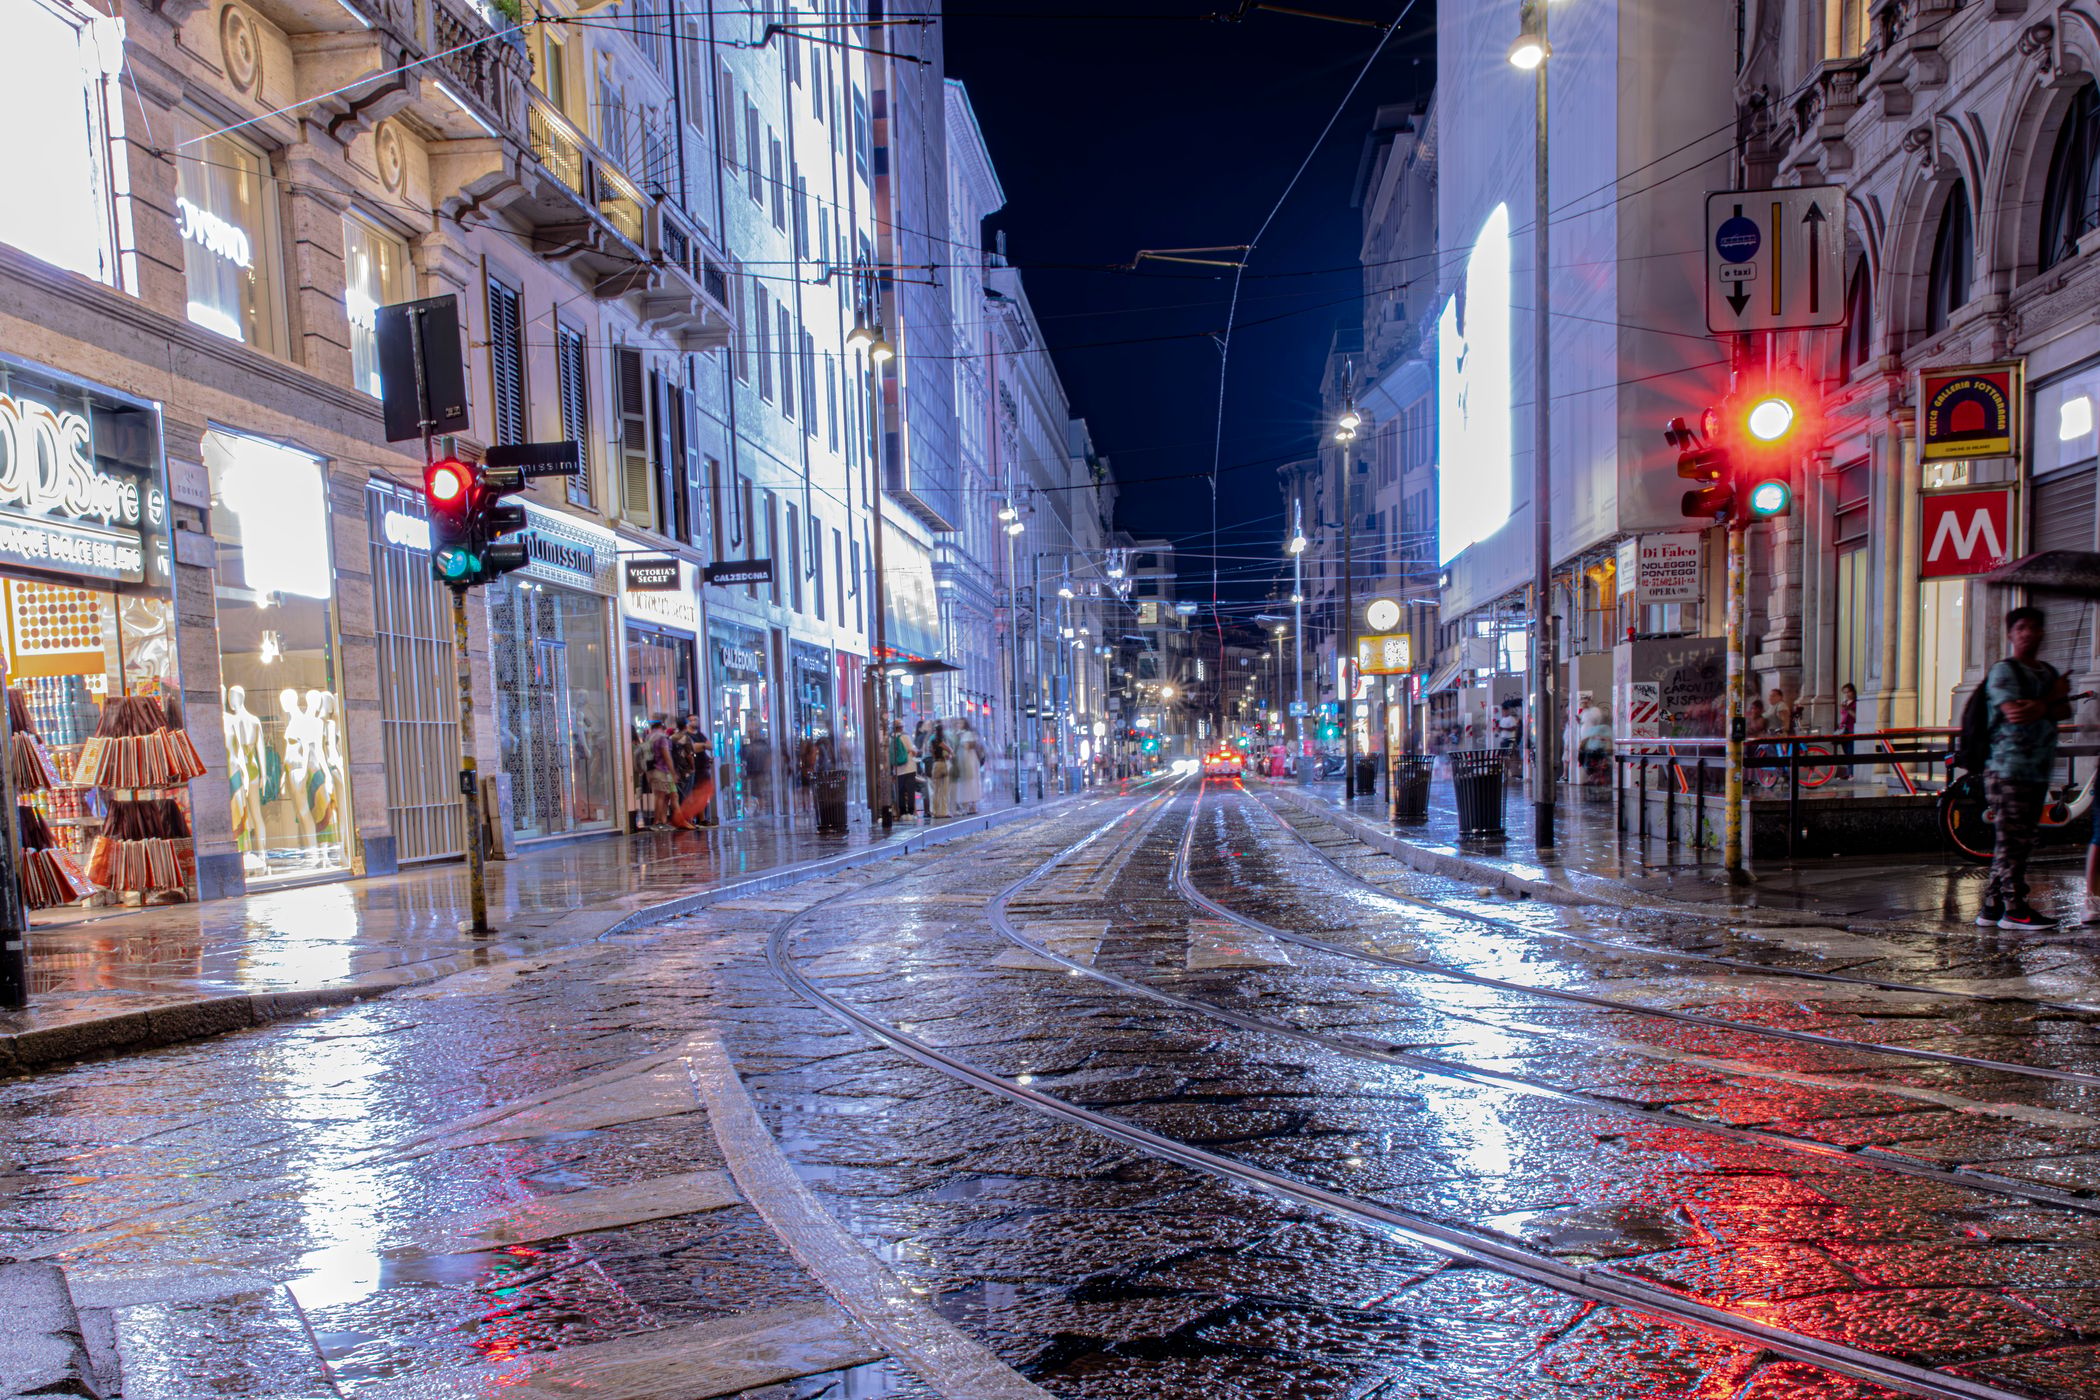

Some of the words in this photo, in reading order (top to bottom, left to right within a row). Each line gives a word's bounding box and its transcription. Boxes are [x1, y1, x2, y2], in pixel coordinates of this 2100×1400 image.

[1733, 268, 1751, 277] taxi
[1929, 409, 1939, 436] CIVICA
[1934, 380, 1971, 407] GALLERIA
[1973, 381, 2007, 431] SOTTERRANEA
[1927, 508, 2001, 562] M
[1643, 548, 1657, 558] Di
[1661, 546, 1696, 557] Falco
[1641, 561, 1696, 570] NOLEGGIO
[630, 567, 676, 577] VICTORIA'S
[713, 571, 769, 583] CALZEDONIA
[1641, 569, 1696, 577] PONTEGGI
[638, 575, 668, 583] SECRET
[1649, 587, 1676, 596] OPERA
[722, 647, 759, 673] CALZEDONIA
